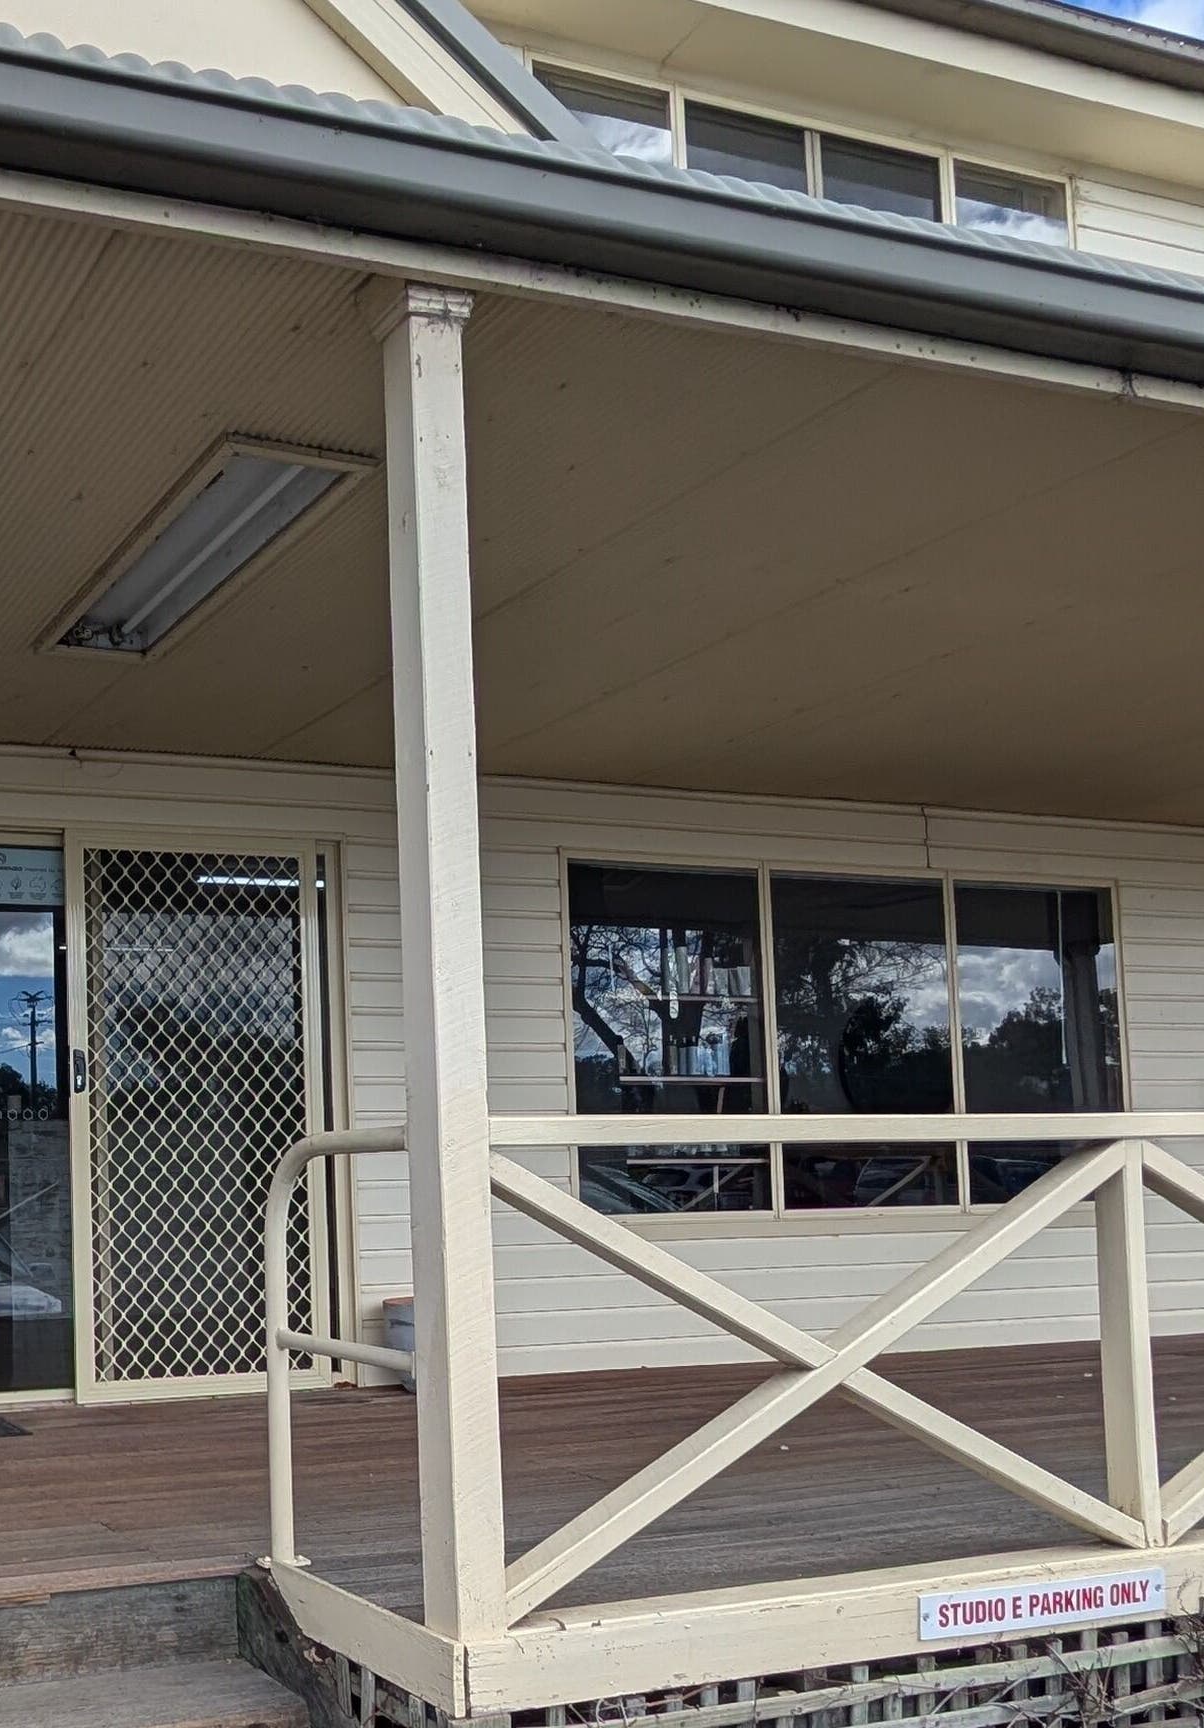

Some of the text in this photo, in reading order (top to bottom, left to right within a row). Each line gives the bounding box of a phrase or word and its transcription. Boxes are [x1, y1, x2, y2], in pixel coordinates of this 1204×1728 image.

[938, 1579, 1150, 1628] STUDIO E PARKING ONLY
